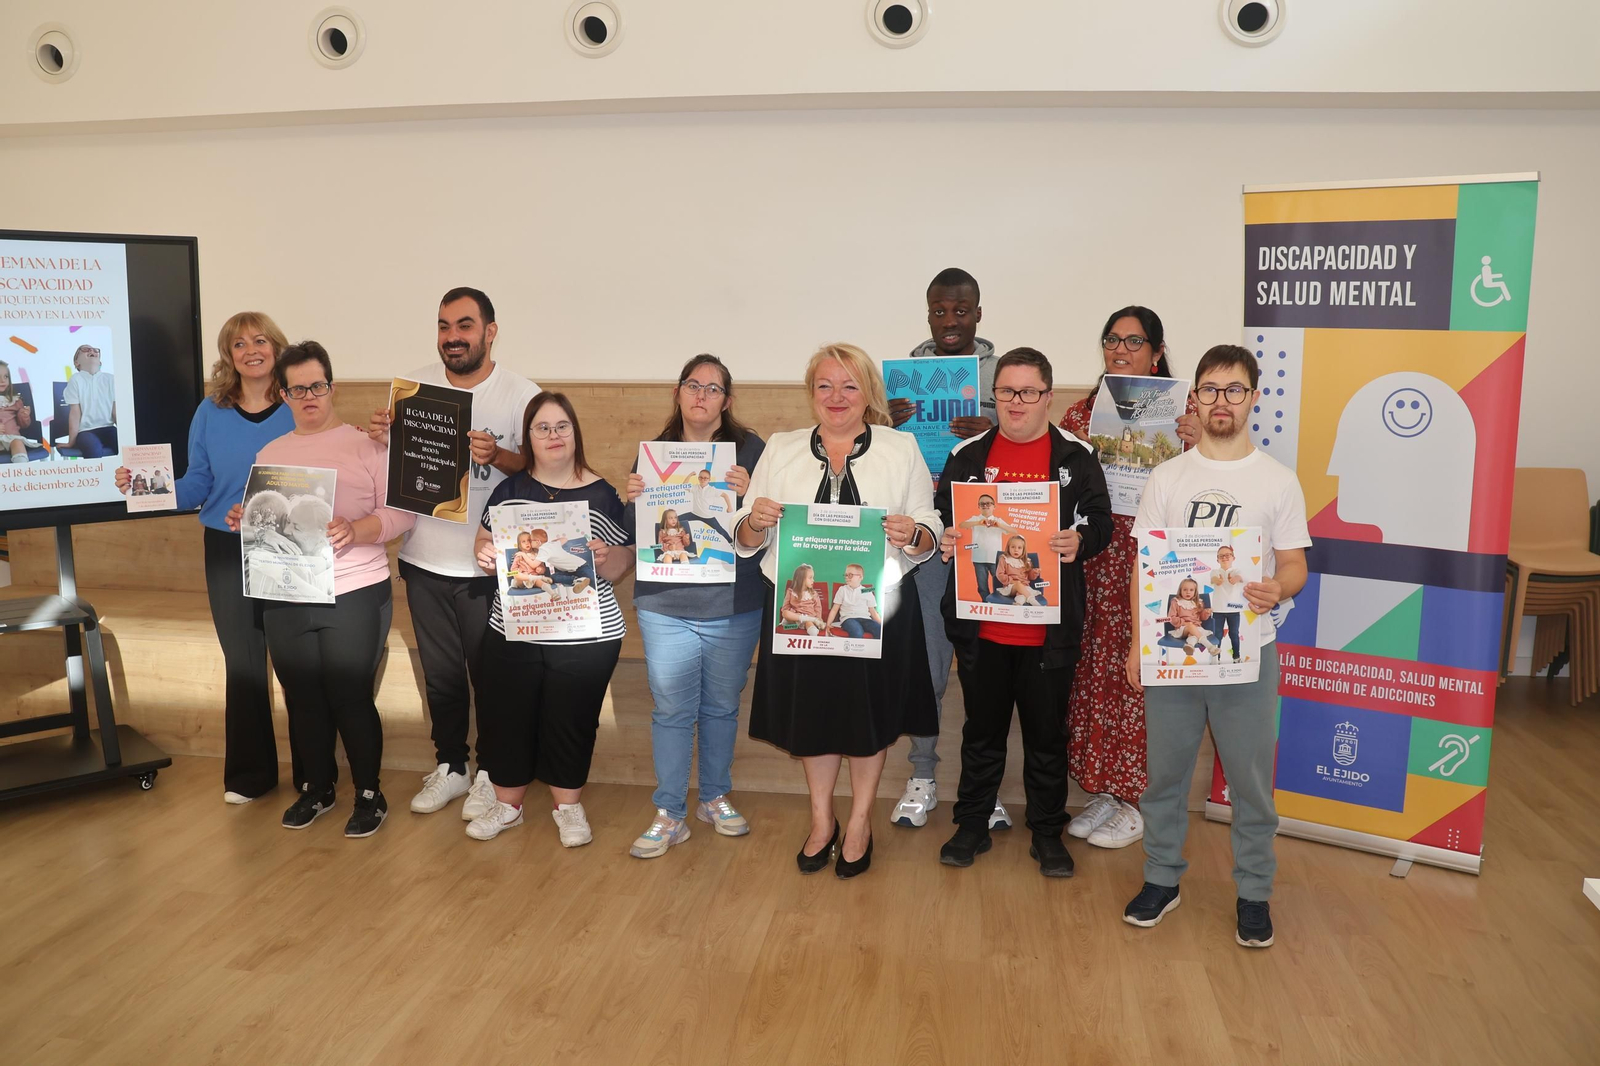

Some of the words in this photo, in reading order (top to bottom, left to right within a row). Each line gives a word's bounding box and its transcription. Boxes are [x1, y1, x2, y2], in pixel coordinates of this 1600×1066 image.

[1, 256, 56, 270] EMANA
[60, 258, 80, 270] DE
[83, 259, 102, 270] LA
[1258, 245, 1397, 270] DISCAPACIDAD
[1403, 244, 1417, 270] Y
[1256, 281, 1322, 306] SALUD
[1330, 281, 1416, 306] MENTAL
[53, 296, 110, 304] MOLESTAN
[4, 310, 34, 319] ROPA
[36, 310, 43, 319] Y
[45, 310, 59, 319] EN
[62, 310, 74, 319] LA
[887, 367, 970, 396] PLAY
[412, 409, 432, 420] GALA
[432, 412, 444, 422] DE
[444, 415, 454, 424] LA
[404, 418, 456, 436] DISCAPACIDAD
[424, 440, 450, 450] noviembre
[403, 450, 426, 460] Auditorio
[426, 456, 450, 466] Municipal
[0, 468, 10, 478] el
[13, 469, 22, 477] 18
[25, 468, 37, 476] de
[40, 464, 93, 475] noviembre
[95, 463, 104, 472] al
[426, 463, 438, 472] Ejido
[2, 484, 6, 493] 3
[9, 483, 21, 492] de
[24, 480, 74, 491] diciembre
[77, 478, 100, 487] 2025
[656, 484, 692, 492] etiquetas
[650, 491, 686, 500] molestan
[1019, 508, 1048, 516] etiquetas
[805, 536, 837, 544] etiquetas
[651, 566, 674, 576] XIII
[522, 602, 554, 611] etiquetas
[556, 597, 590, 606] molestan
[970, 605, 993, 616] XIII
[516, 626, 539, 635] XIII
[787, 638, 812, 649] XIII
[1156, 669, 1184, 679] XIII
[1280, 652, 1296, 668] LÍA
[1299, 656, 1312, 670] DE
[1316, 658, 1396, 683] DISCAPACIDAD,
[1400, 670, 1435, 688] SALUD
[1438, 676, 1484, 695] MENTAL
[1285, 672, 1350, 694] PREVENCIÓN
[1353, 682, 1367, 696] DE
[1370, 686, 1436, 707] ADICCIONES
[1316, 764, 1330, 776] EL
[1334, 768, 1370, 782] EJIDO
[1322, 776, 1362, 788] AYUNTAMIENTO
